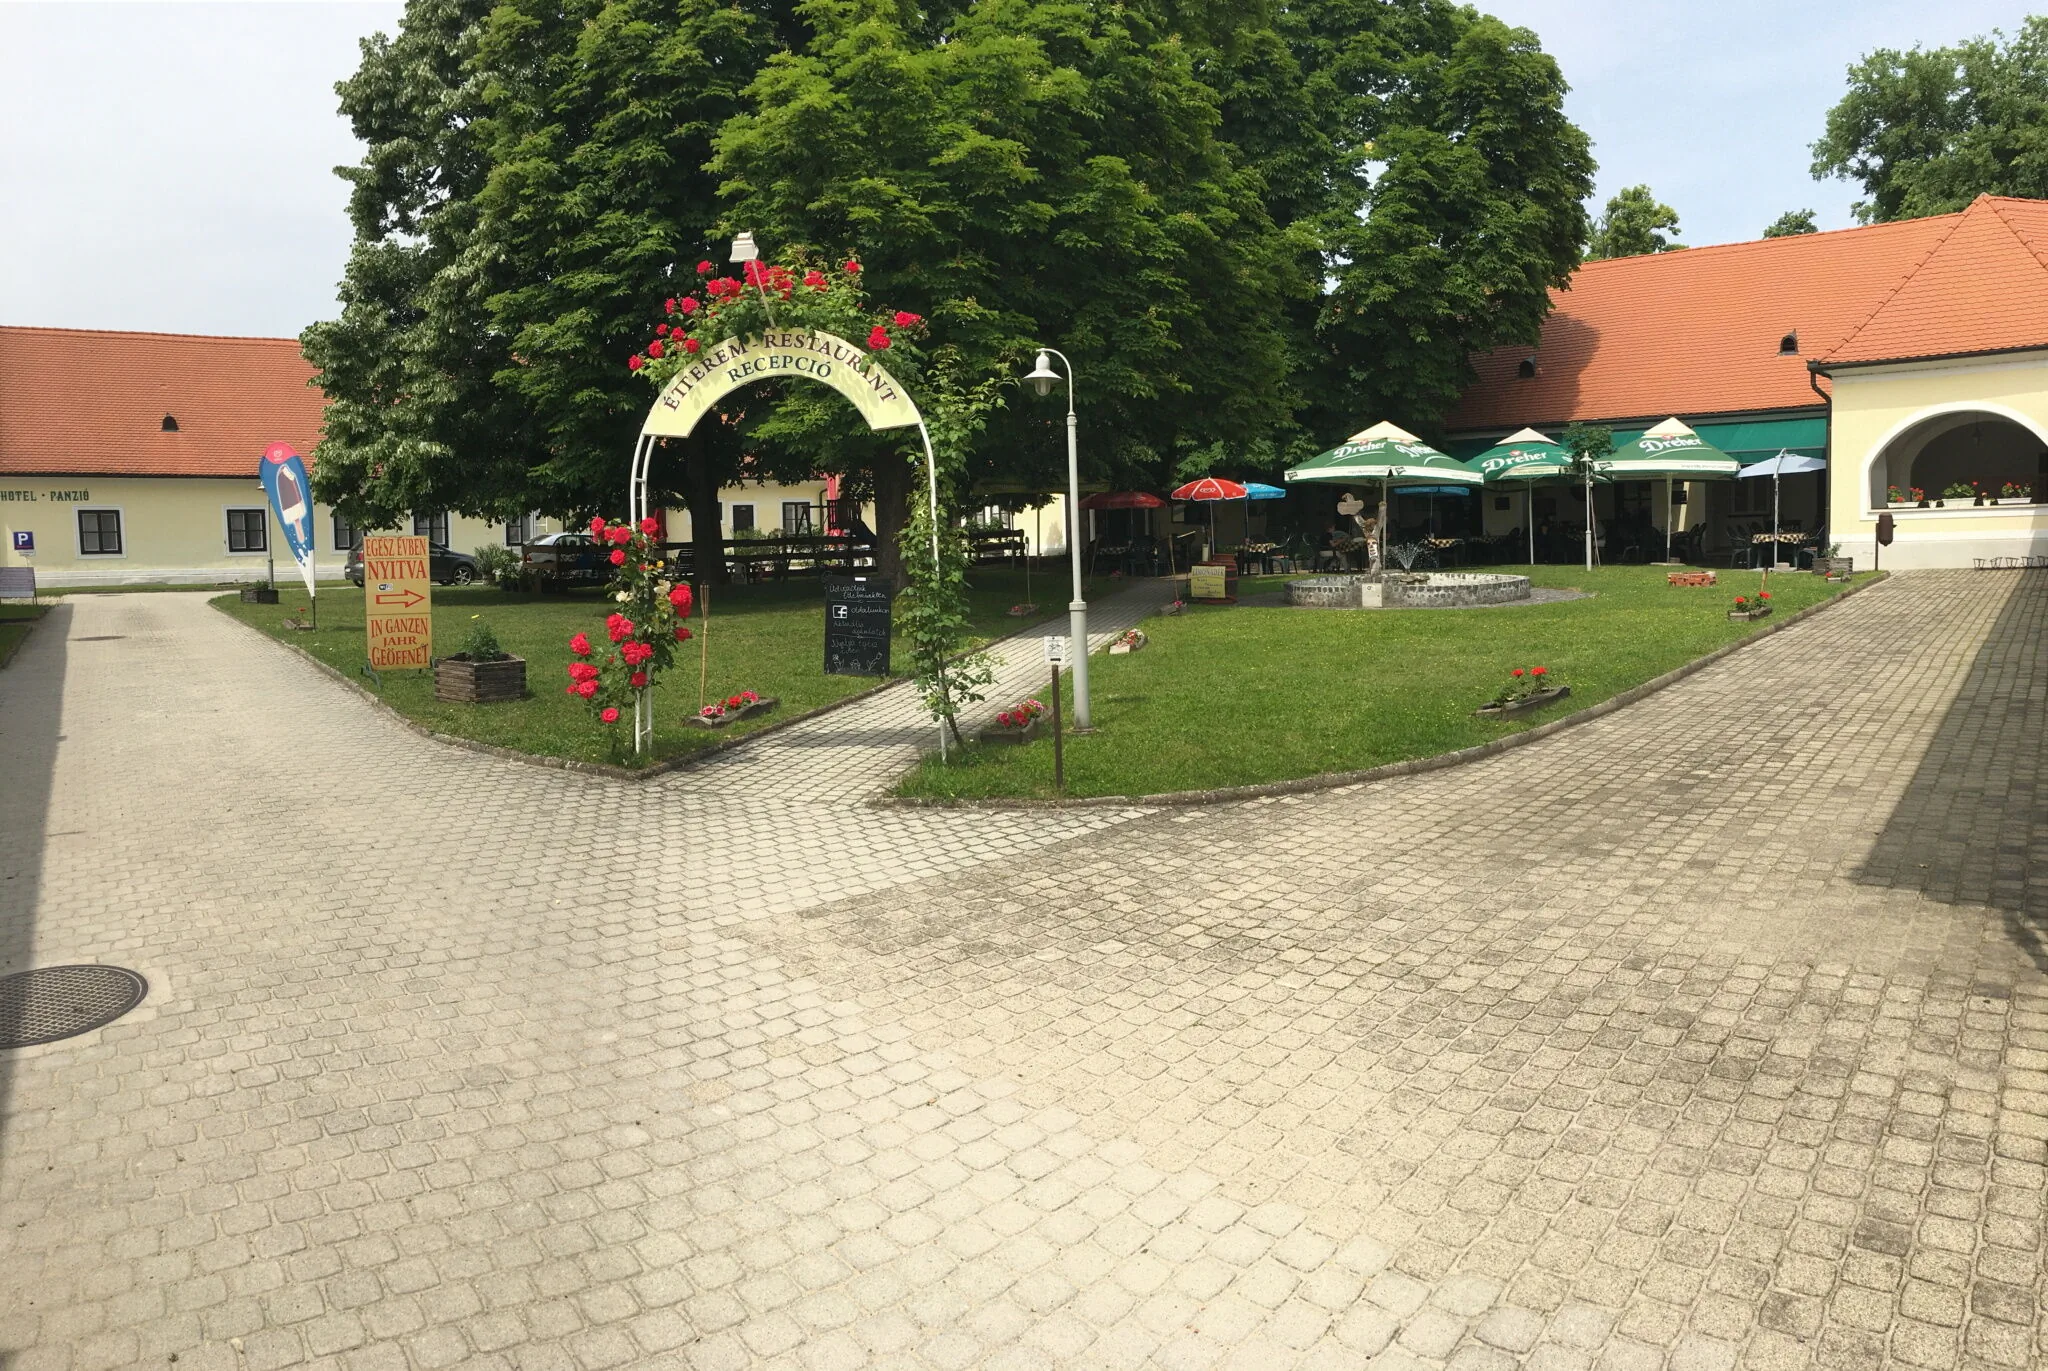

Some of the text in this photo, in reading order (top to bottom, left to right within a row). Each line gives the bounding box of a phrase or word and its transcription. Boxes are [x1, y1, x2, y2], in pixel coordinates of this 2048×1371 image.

[663, 341, 748, 412] ÉTTEREM
[727, 355, 832, 383] RECEPCIÓ
[1332, 441, 1387, 459] Dreher
[1639, 437, 1703, 453] Dreher
[1481, 451, 1547, 475] Dreher
[0, 488, 90, 501] HOTEL PANZIÓ
[17, 533, 28, 545] P
[366, 536, 426, 557] EGÉSZ ÉVBEN
[368, 560, 427, 580] NYITVA
[371, 617, 428, 639] IN GANZEN
[383, 636, 417, 647] JAHR
[371, 643, 428, 666] GEÖFFNET
